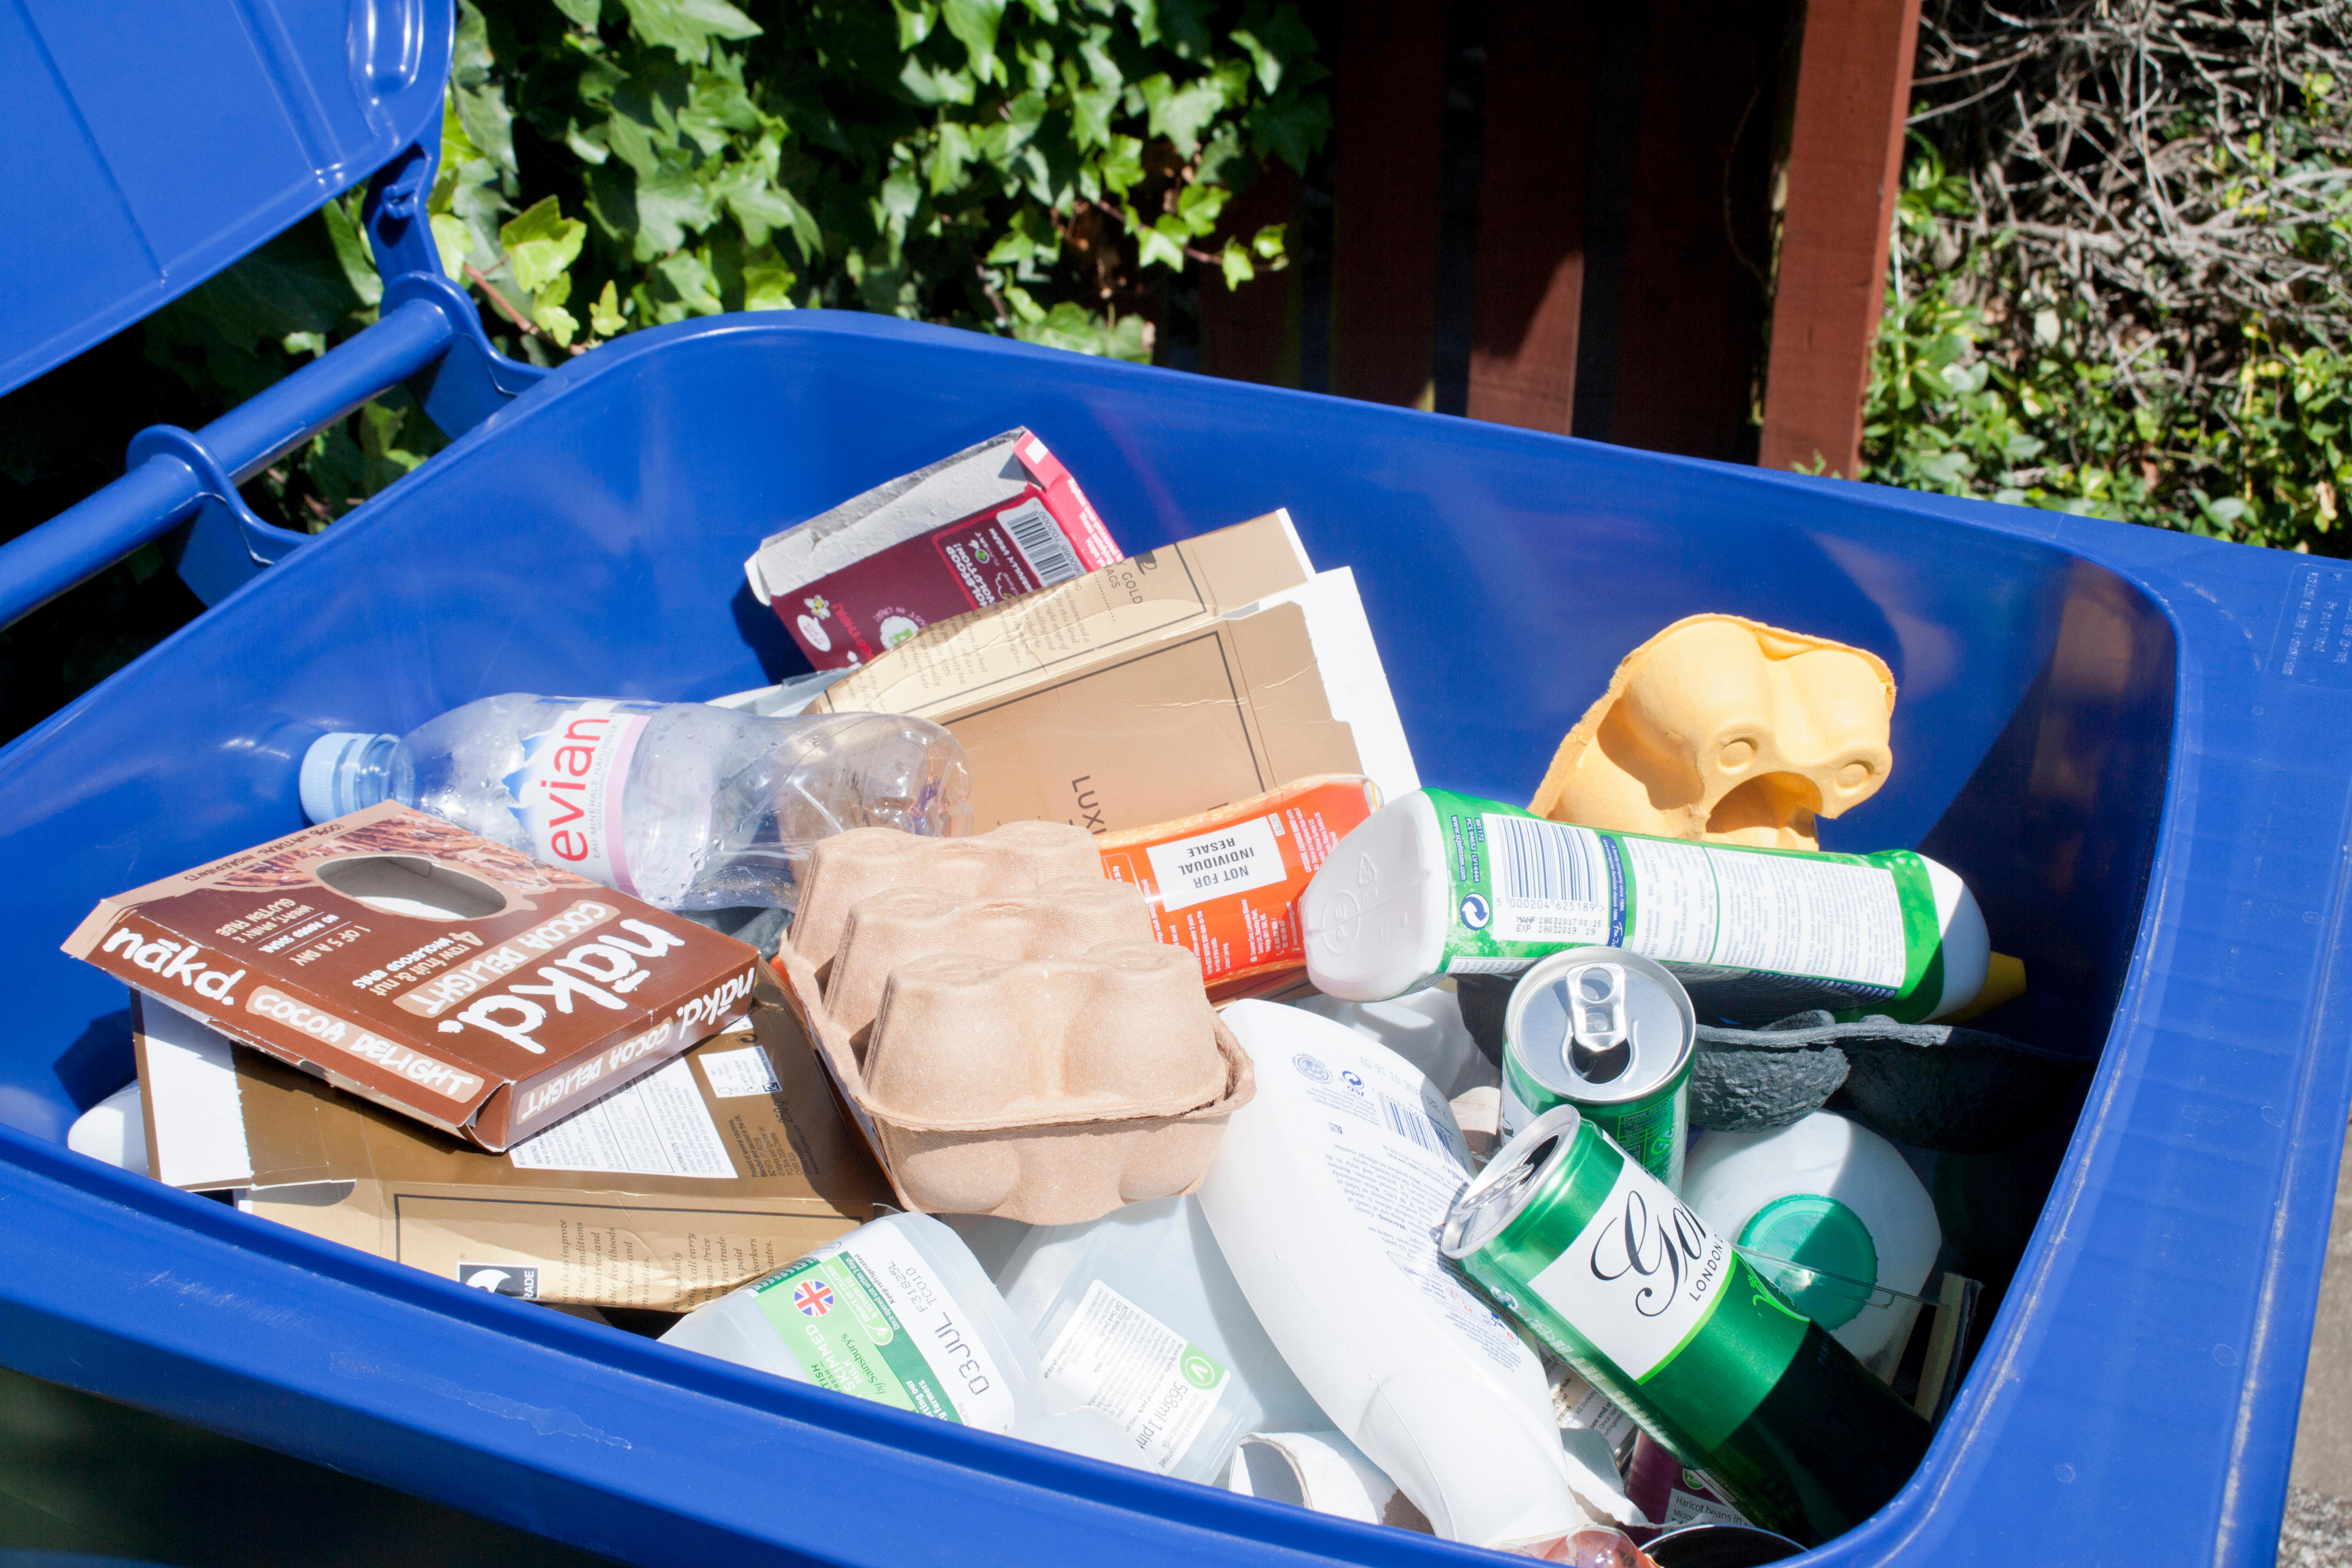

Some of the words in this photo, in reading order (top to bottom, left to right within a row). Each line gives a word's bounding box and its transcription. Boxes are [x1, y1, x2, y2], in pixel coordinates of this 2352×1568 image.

[1037, 510, 1062, 543] 702000
[1078, 511, 1095, 534] These
[988, 527, 1009, 556] VEGAN
[1084, 536, 1101, 559] Hope
[944, 544, 988, 609] HOLEFOOD
[953, 542, 996, 605] VOLUTION!
[1120, 570, 1144, 605] GOLD
[1044, 603, 1057, 622] right
[1059, 608, 1070, 623] this
[1065, 622, 1079, 644] blend
[1077, 621, 1088, 635] and
[1044, 634, 1056, 650] and
[541, 719, 610, 862] evian
[589, 779, 599, 835] MINERALE
[1465, 817, 1473, 830] PCS
[1474, 818, 1484, 842] 881172
[257, 834, 310, 855] NATURAL
[1187, 837, 1235, 857] RESALE
[1451, 815, 1468, 881] www.scjohnson.com
[1467, 830, 1477, 851] 94652
[1177, 847, 1254, 876] INDIVIDUAL
[1605, 847, 1614, 870] entreprise
[1611, 848, 1620, 863] family
[183, 854, 256, 881] INGREDIENTS
[1222, 865, 1249, 881] NOT
[1470, 853, 1480, 882] LV14444
[1615, 863, 1624, 884] company
[1192, 873, 1218, 889] FOR
[245, 896, 296, 923] GLUTEN
[272, 903, 314, 923] WHEAT,
[1510, 899, 1549, 909] 000204
[1556, 901, 1595, 912] 625189
[214, 919, 251, 937] FREE
[243, 920, 278, 938] DAIRY
[291, 919, 326, 938] ADDED
[321, 913, 339, 924] NO
[517, 903, 606, 949] COCOA
[1539, 917, 1576, 925] 28032017
[337, 929, 360, 943] OF
[448, 931, 483, 946] 4
[1538, 925, 1576, 934] 28032019
[258, 934, 295, 953] SUGAR
[314, 942, 333, 952] A
[326, 937, 344, 947] 5
[438, 944, 470, 960] raw
[289, 947, 321, 966] DAY
[385, 937, 454, 972] WHOLEFOOD
[393, 970, 418, 982] &
[409, 955, 447, 977] fruit
[352, 969, 389, 990] BARS
[369, 977, 401, 998] nut
[409, 951, 528, 1014] DELIGHT
[254, 993, 347, 1042] COCOA
[351, 1033, 474, 1095] DELIGHT
[609, 1022, 671, 1066] COCOA
[521, 1061, 602, 1120] DELIGHT
[1623, 1111, 1647, 1122] DRINK
[736, 1138, 748, 1155] several
[743, 1134, 755, 1151] packed
[669, 1141, 688, 1174] INFORMATION
[745, 1159, 758, 1178] Product
[754, 1159, 767, 1178] Blended
[558, 1219, 569, 1257] improve
[574, 1221, 587, 1273] conditions
[591, 1231, 602, 1251] and
[686, 1232, 697, 1259] carry
[607, 1227, 618, 1281] livelihoods
[623, 1241, 634, 1260] and
[701, 1238, 714, 1262] Price
[716, 1236, 730, 1282] Fairtrade
[733, 1247, 745, 1271] paid
[748, 1238, 761, 1275] workers
[671, 1252, 682, 1274] only
[687, 1260, 697, 1274] all
[843, 1255, 857, 1271] days
[853, 1251, 884, 1290] refrigerated
[1689, 1244, 1723, 1302] LONDON
[593, 1253, 602, 1302] countries
[856, 1271, 871, 1288] within
[844, 1290, 855, 1302] OF
[867, 1286, 877, 1298] use
[880, 1286, 896, 1305] Keep
[851, 1300, 871, 1323] SOURCE
[873, 1295, 892, 1317] opened
[1116, 1305, 1129, 1320] BOTTLE
[887, 1315, 900, 1330] Once
[803, 1321, 857, 1394] SKIMMED
[839, 1331, 878, 1385] Sainsbury's
[842, 1357, 863, 1385] MILK
[1156, 1373, 1165, 1383] see
[870, 1378, 889, 1398] by
[905, 1378, 919, 1394] our
[917, 1378, 942, 1414] farmers
[1149, 1381, 1161, 1396] front
[1153, 1380, 1188, 1423] 568ml
[1182, 1398, 1210, 1434] Pasteurised
[1589, 1418, 1599, 1429] see
[1596, 1406, 1608, 1419] end
[1132, 1425, 1156, 1451] pint
[1159, 1433, 1175, 1449] milk
[1156, 1430, 1189, 1469] homogenised
[1675, 1496, 1704, 1512] Haricot
[1704, 1505, 1732, 1522] beans
[1733, 1516, 1742, 1524] in
